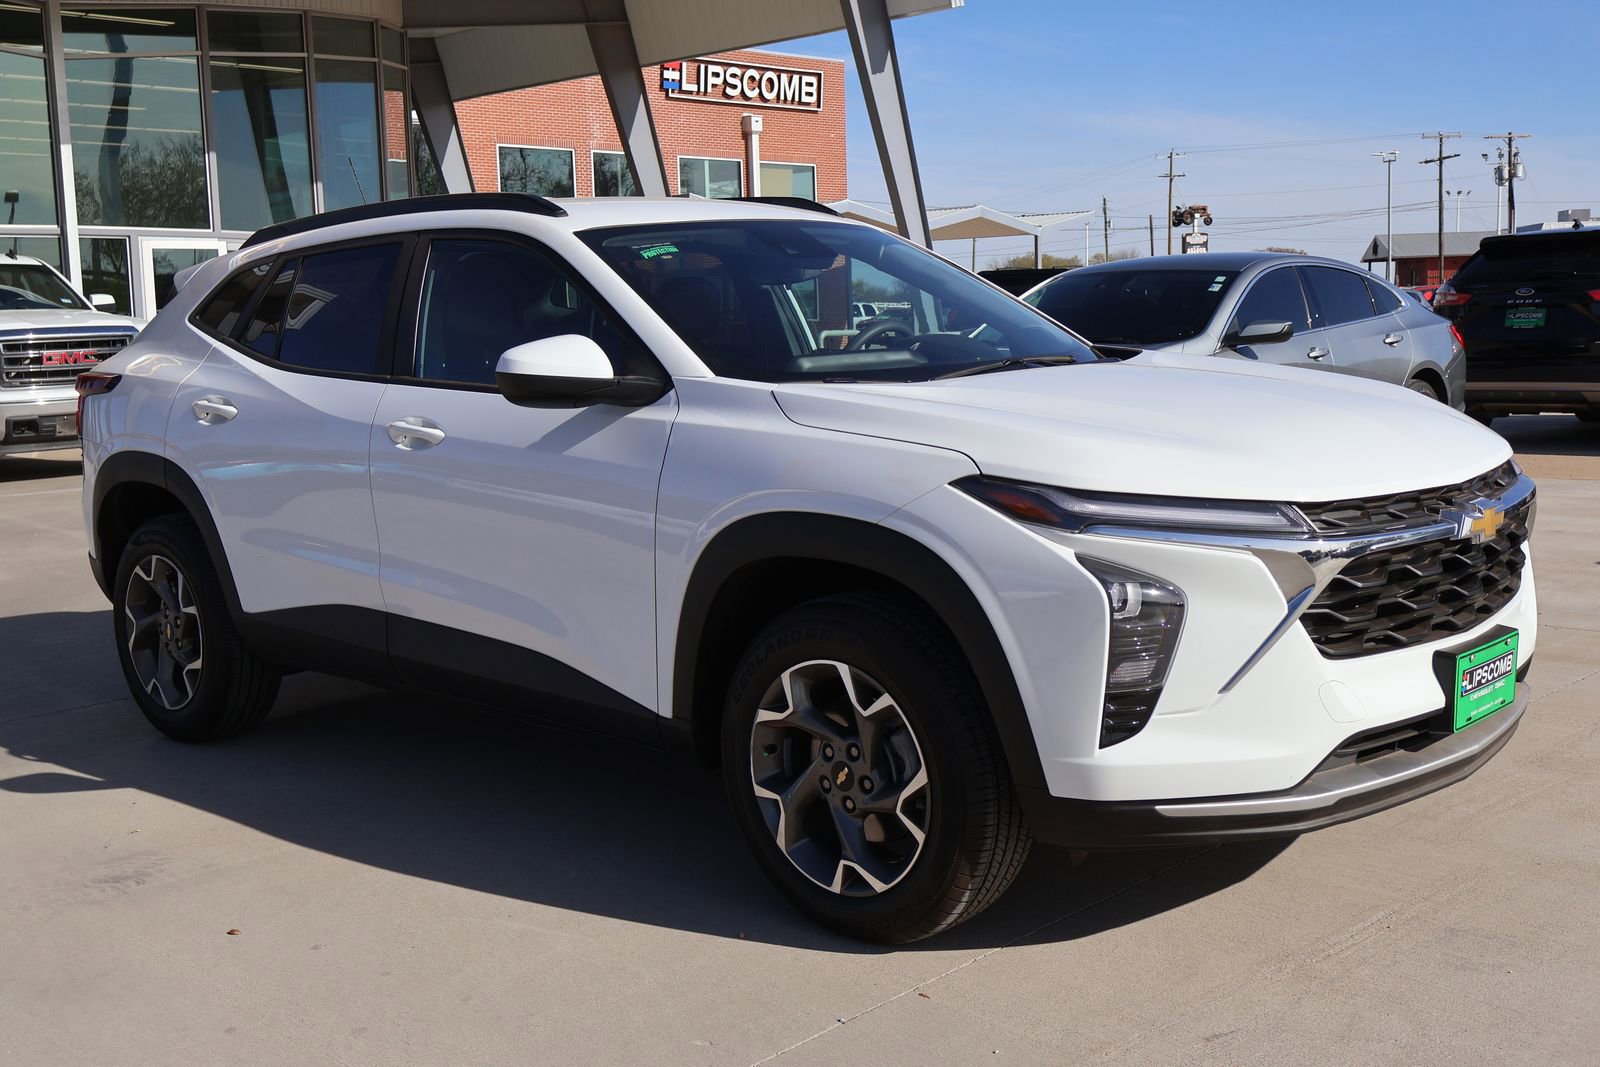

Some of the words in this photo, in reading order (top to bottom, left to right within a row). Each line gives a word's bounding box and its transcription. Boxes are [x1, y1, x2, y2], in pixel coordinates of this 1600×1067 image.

[680, 61, 818, 104] LIPSCOMB
[42, 351, 98, 366] GMC
[734, 627, 833, 704] GEOLANDAR
[1466, 654, 1514, 691] LIPSCOMB
